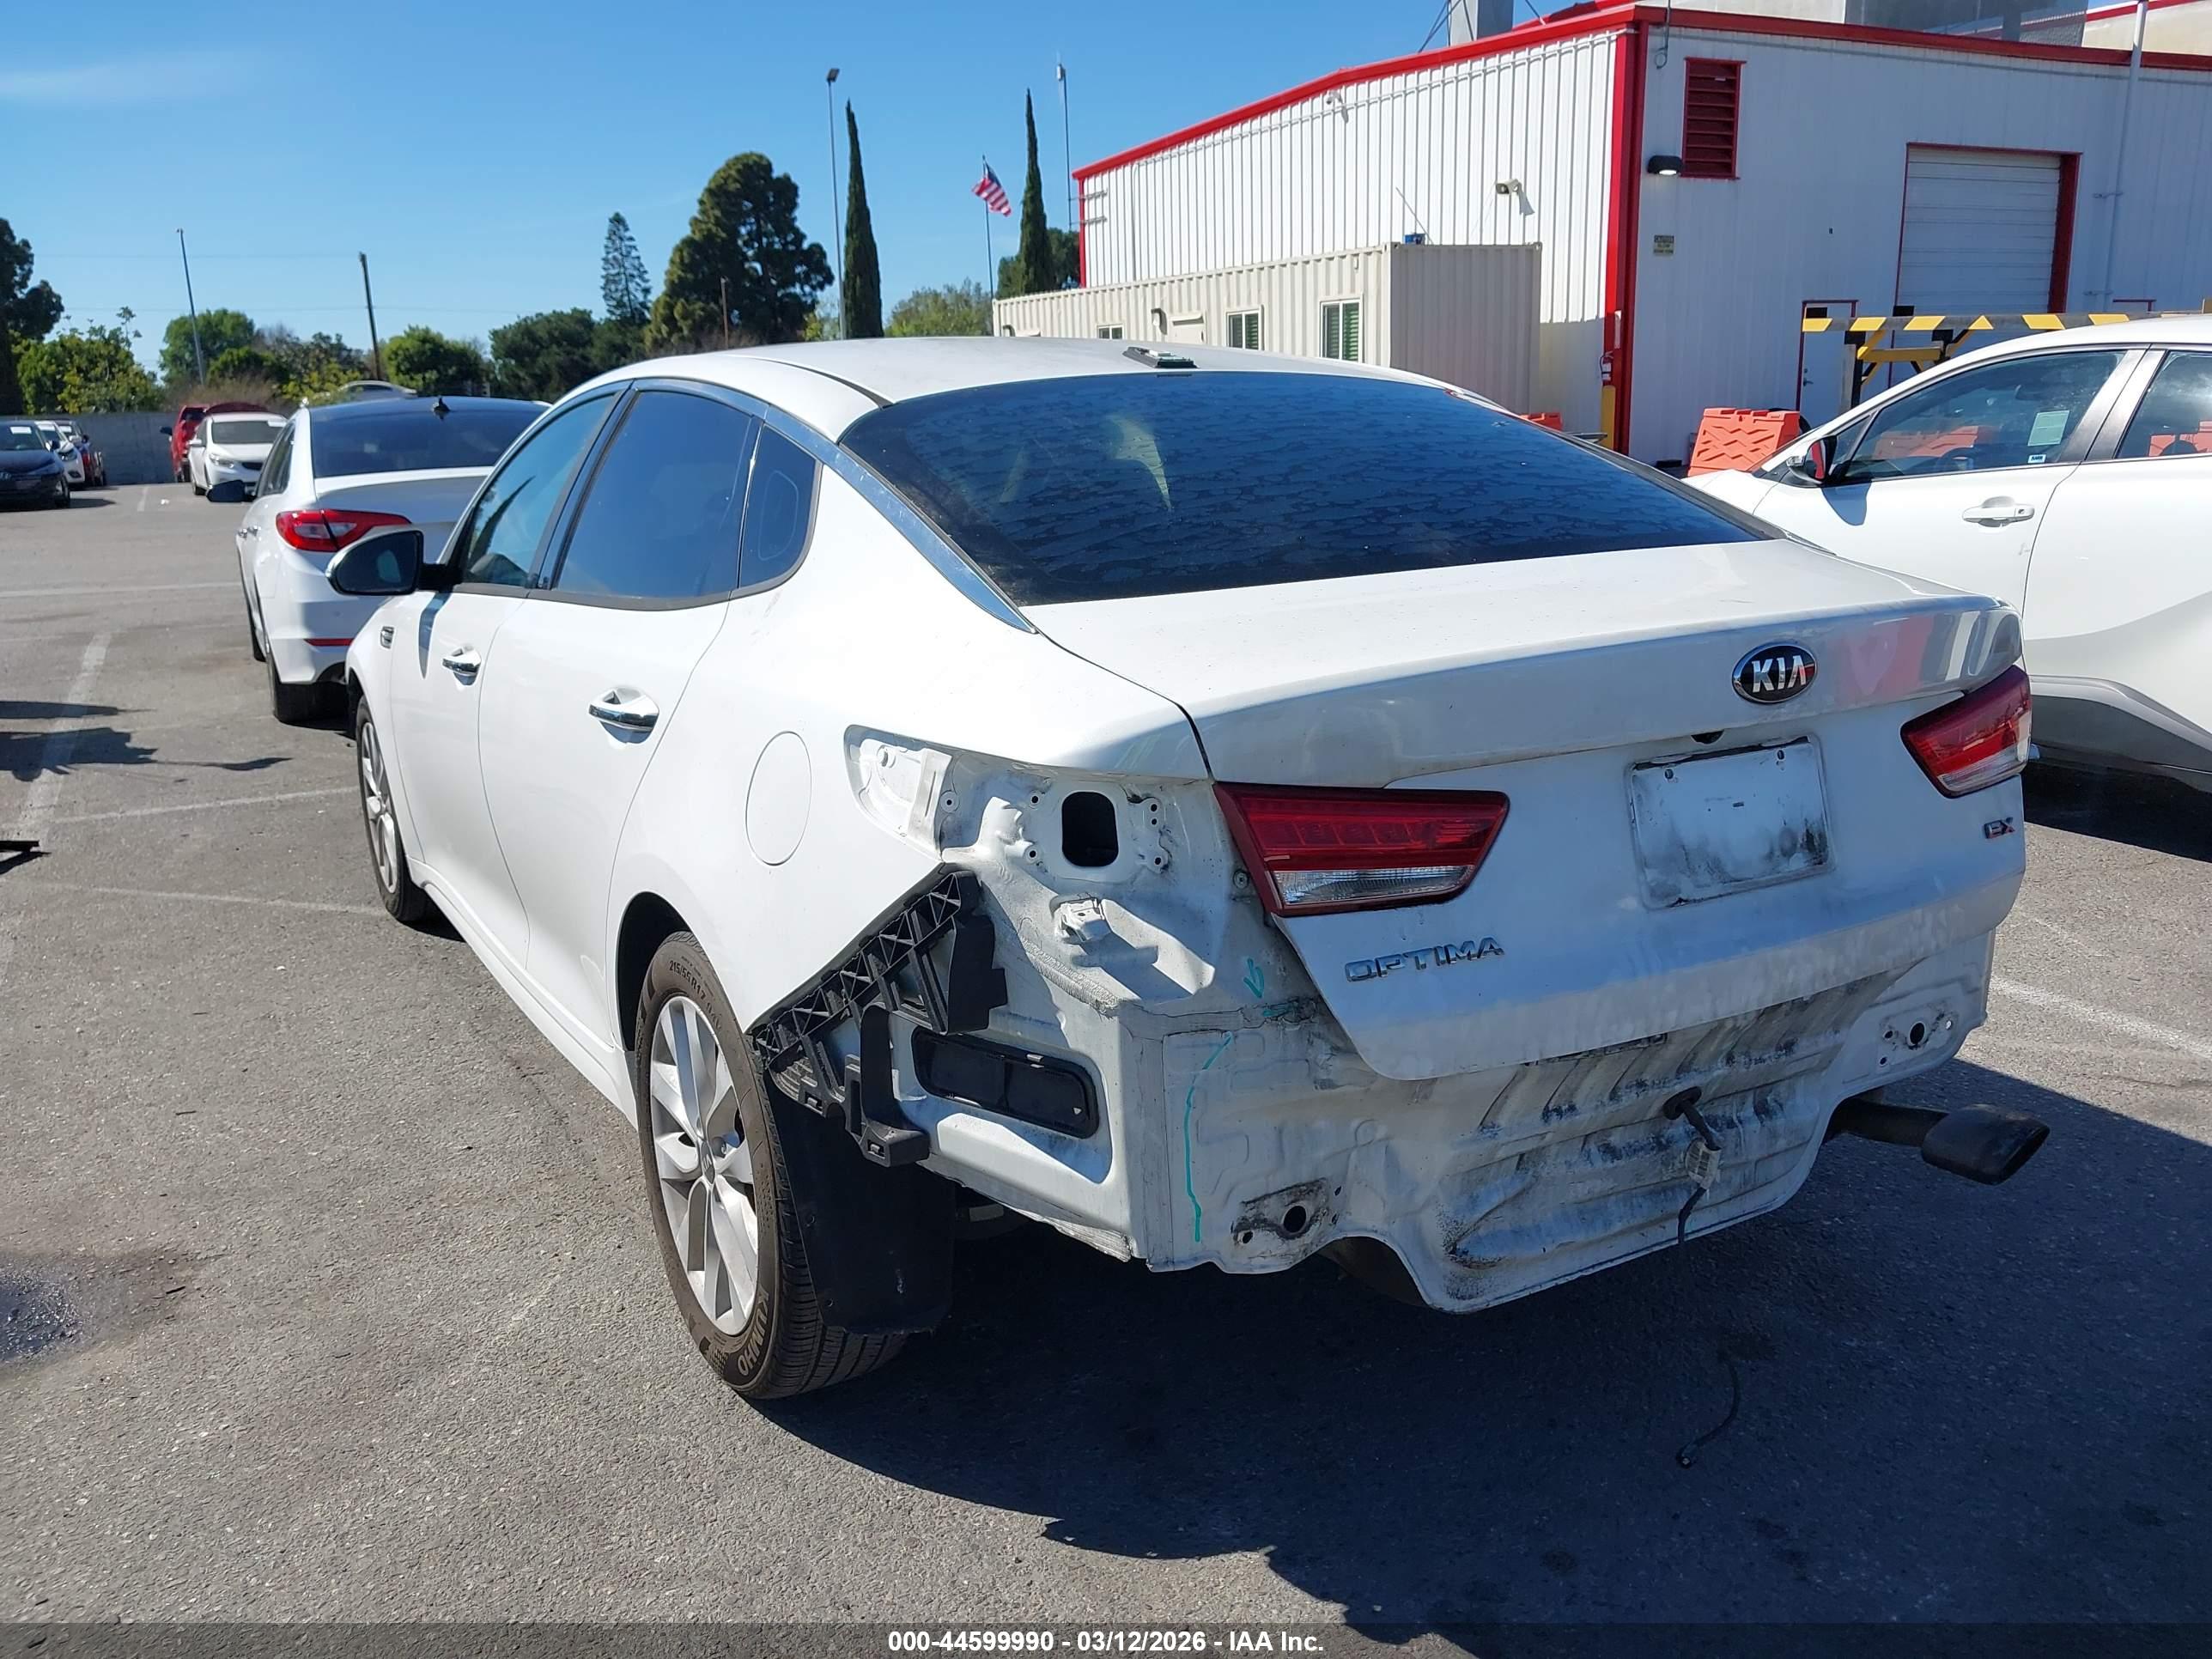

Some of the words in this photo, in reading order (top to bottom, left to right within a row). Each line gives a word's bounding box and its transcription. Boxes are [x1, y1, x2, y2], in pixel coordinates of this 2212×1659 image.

[1751, 654, 1807, 693] KIA
[1984, 817, 2015, 839] EX
[1345, 937, 1505, 982] OPTIMA
[738, 1285, 769, 1376] KUMHO
